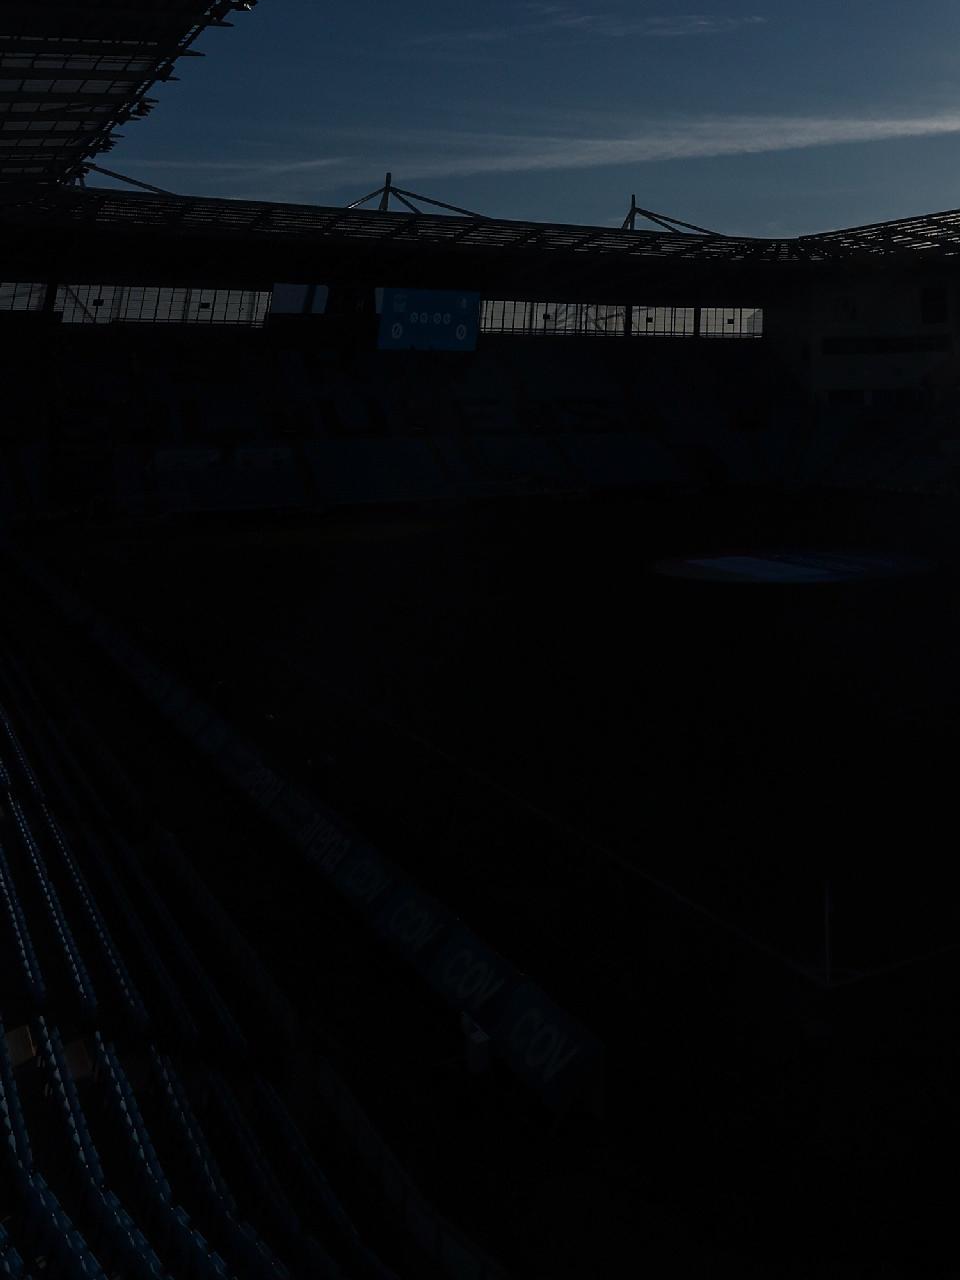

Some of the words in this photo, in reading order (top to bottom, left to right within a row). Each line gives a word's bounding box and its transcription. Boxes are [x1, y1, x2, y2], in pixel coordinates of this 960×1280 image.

[391, 322, 404, 340] 0
[456, 323, 468, 341] 0
[443, 948, 506, 1009] COV
[509, 1007, 581, 1083] COV
